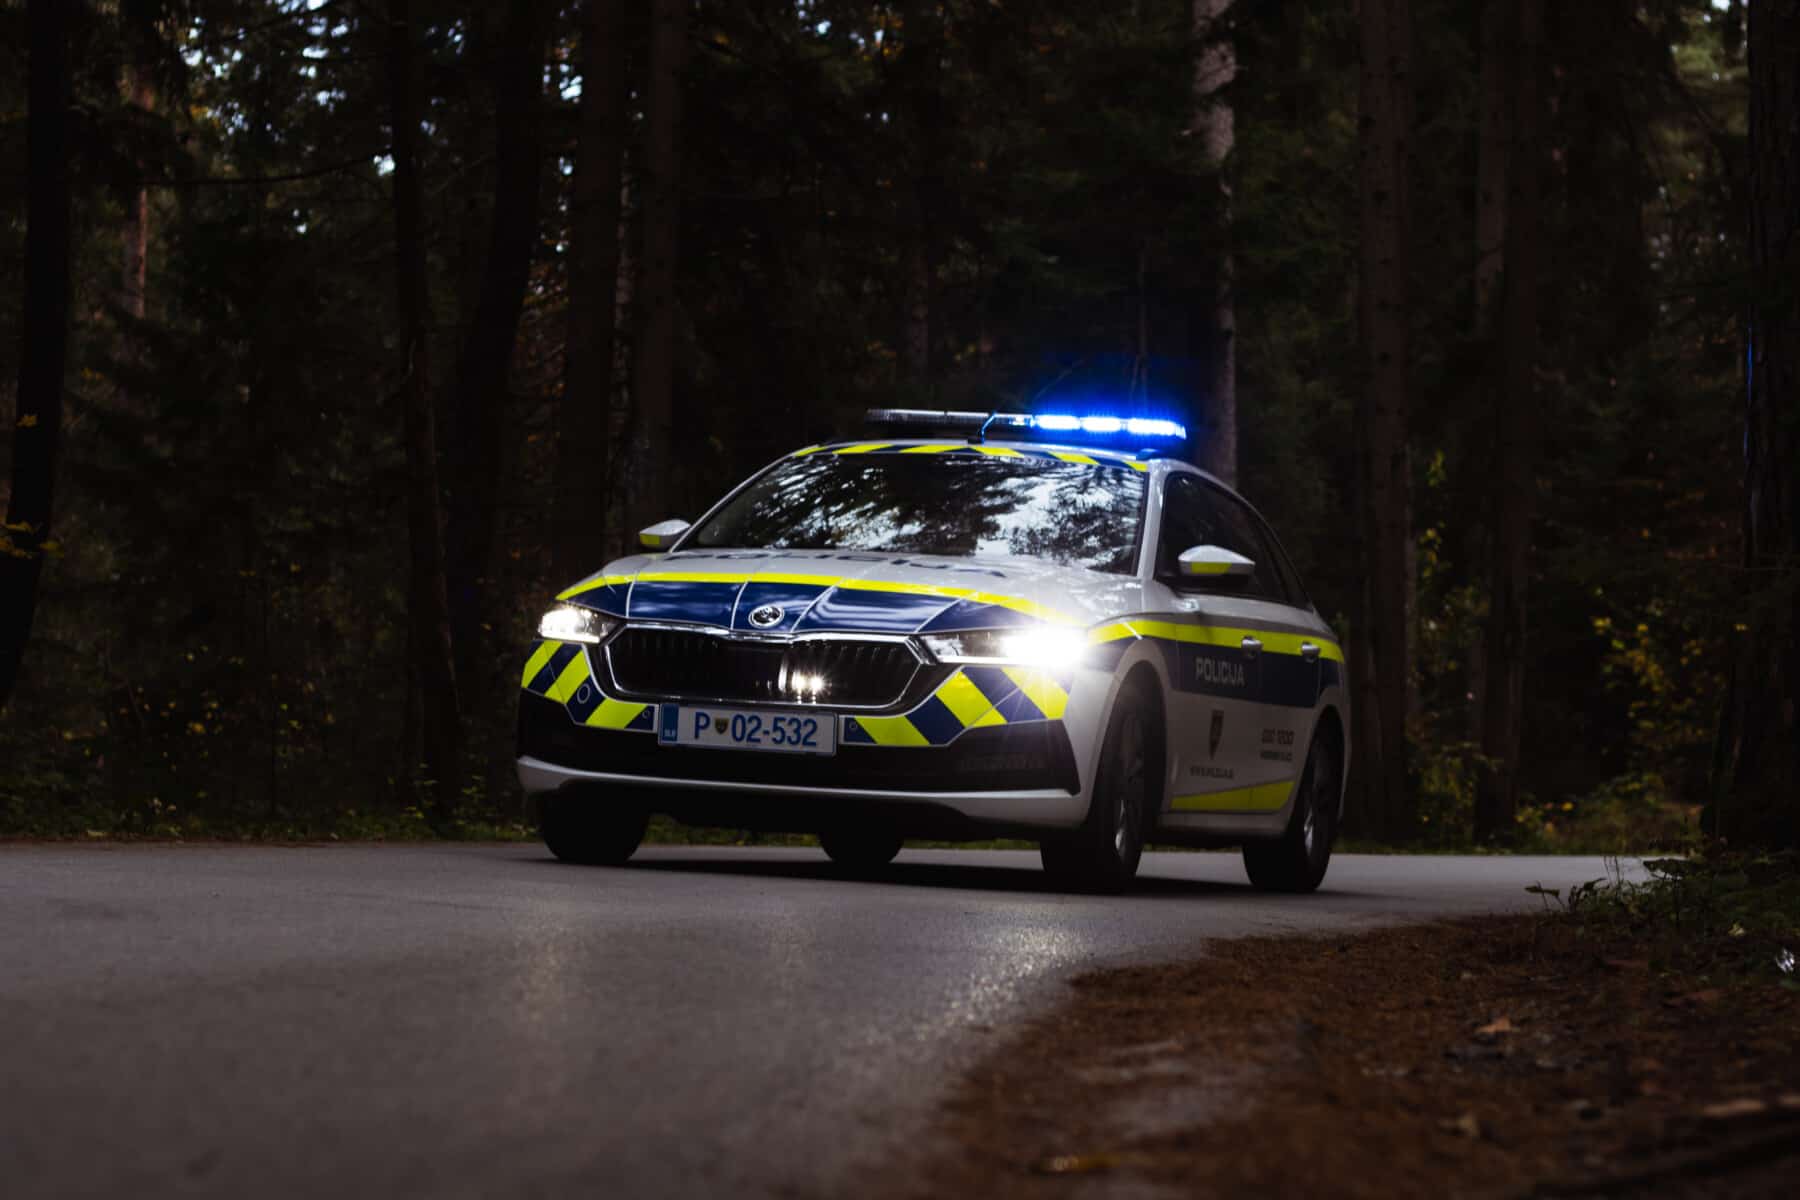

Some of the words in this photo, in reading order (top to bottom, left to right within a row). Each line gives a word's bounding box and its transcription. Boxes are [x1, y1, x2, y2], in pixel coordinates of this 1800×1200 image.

[1194, 657, 1245, 687] POLICIJA
[694, 711, 711, 740] P
[731, 714, 818, 747] 02-532
